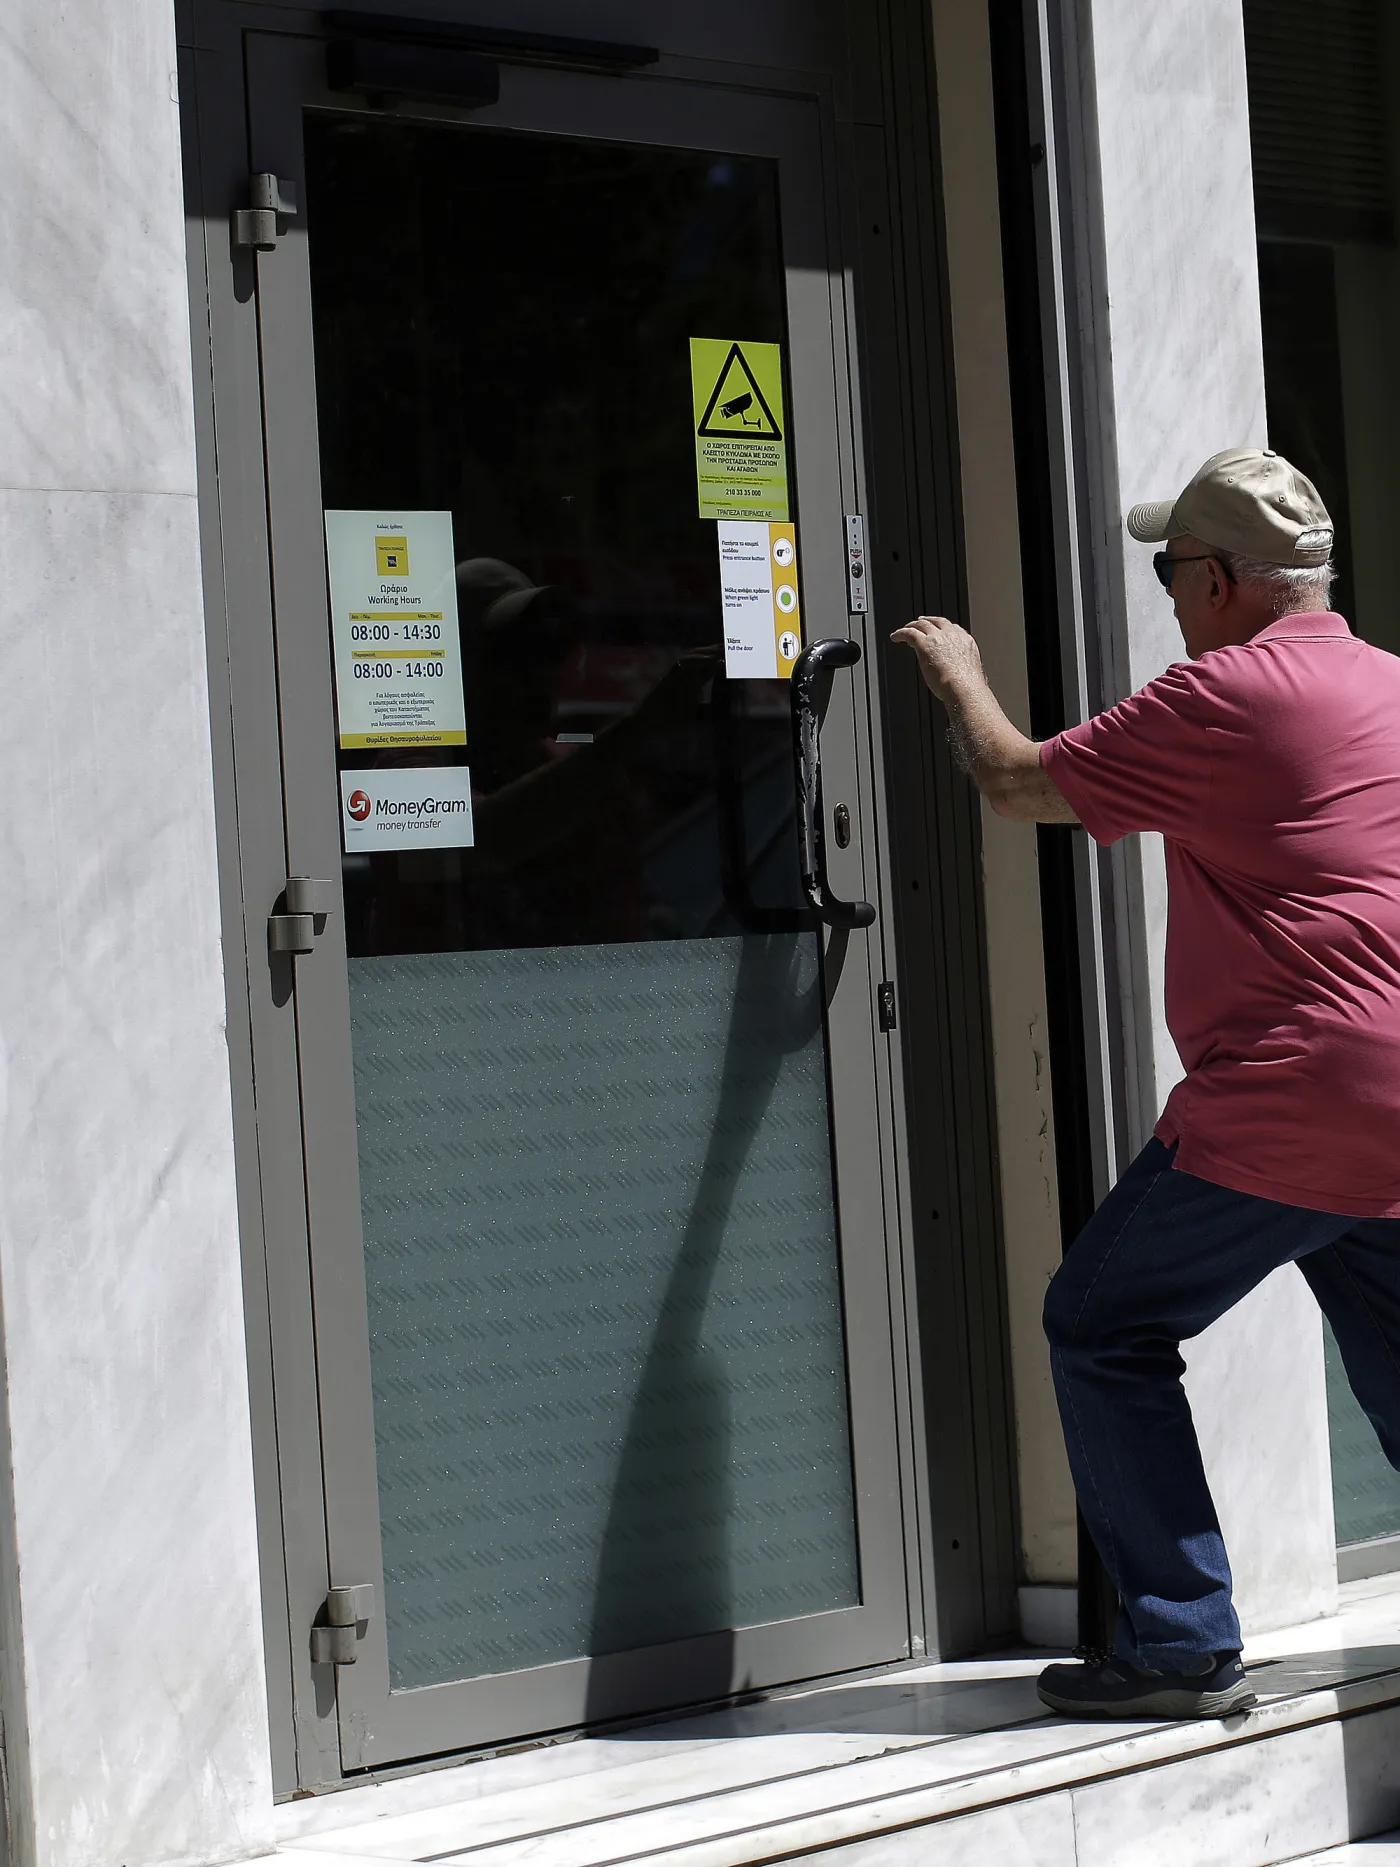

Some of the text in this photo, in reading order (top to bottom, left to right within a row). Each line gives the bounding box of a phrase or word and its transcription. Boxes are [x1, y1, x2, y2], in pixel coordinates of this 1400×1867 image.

[731, 443, 763, 451] ΕΠΙΤΗΡΕΙΤΑΙ
[726, 450, 752, 458] ΚΥΚΛΩΜΑ
[725, 488, 735, 496] 210
[717, 508, 740, 516] ΤΡΑΠΕΖΑ
[380, 584, 408, 595] Ωράριο
[368, 595, 422, 606] Working Hours
[351, 625, 390, 641] 08:00
[402, 624, 441, 640] 14:30
[353, 663, 392, 679] 08:00
[405, 662, 444, 678] 14:00
[366, 734, 442, 744] Θυρίδες Θησαυροφυλακίου
[375, 798, 467, 818] MoneyGram
[376, 818, 442, 832] money transfer
